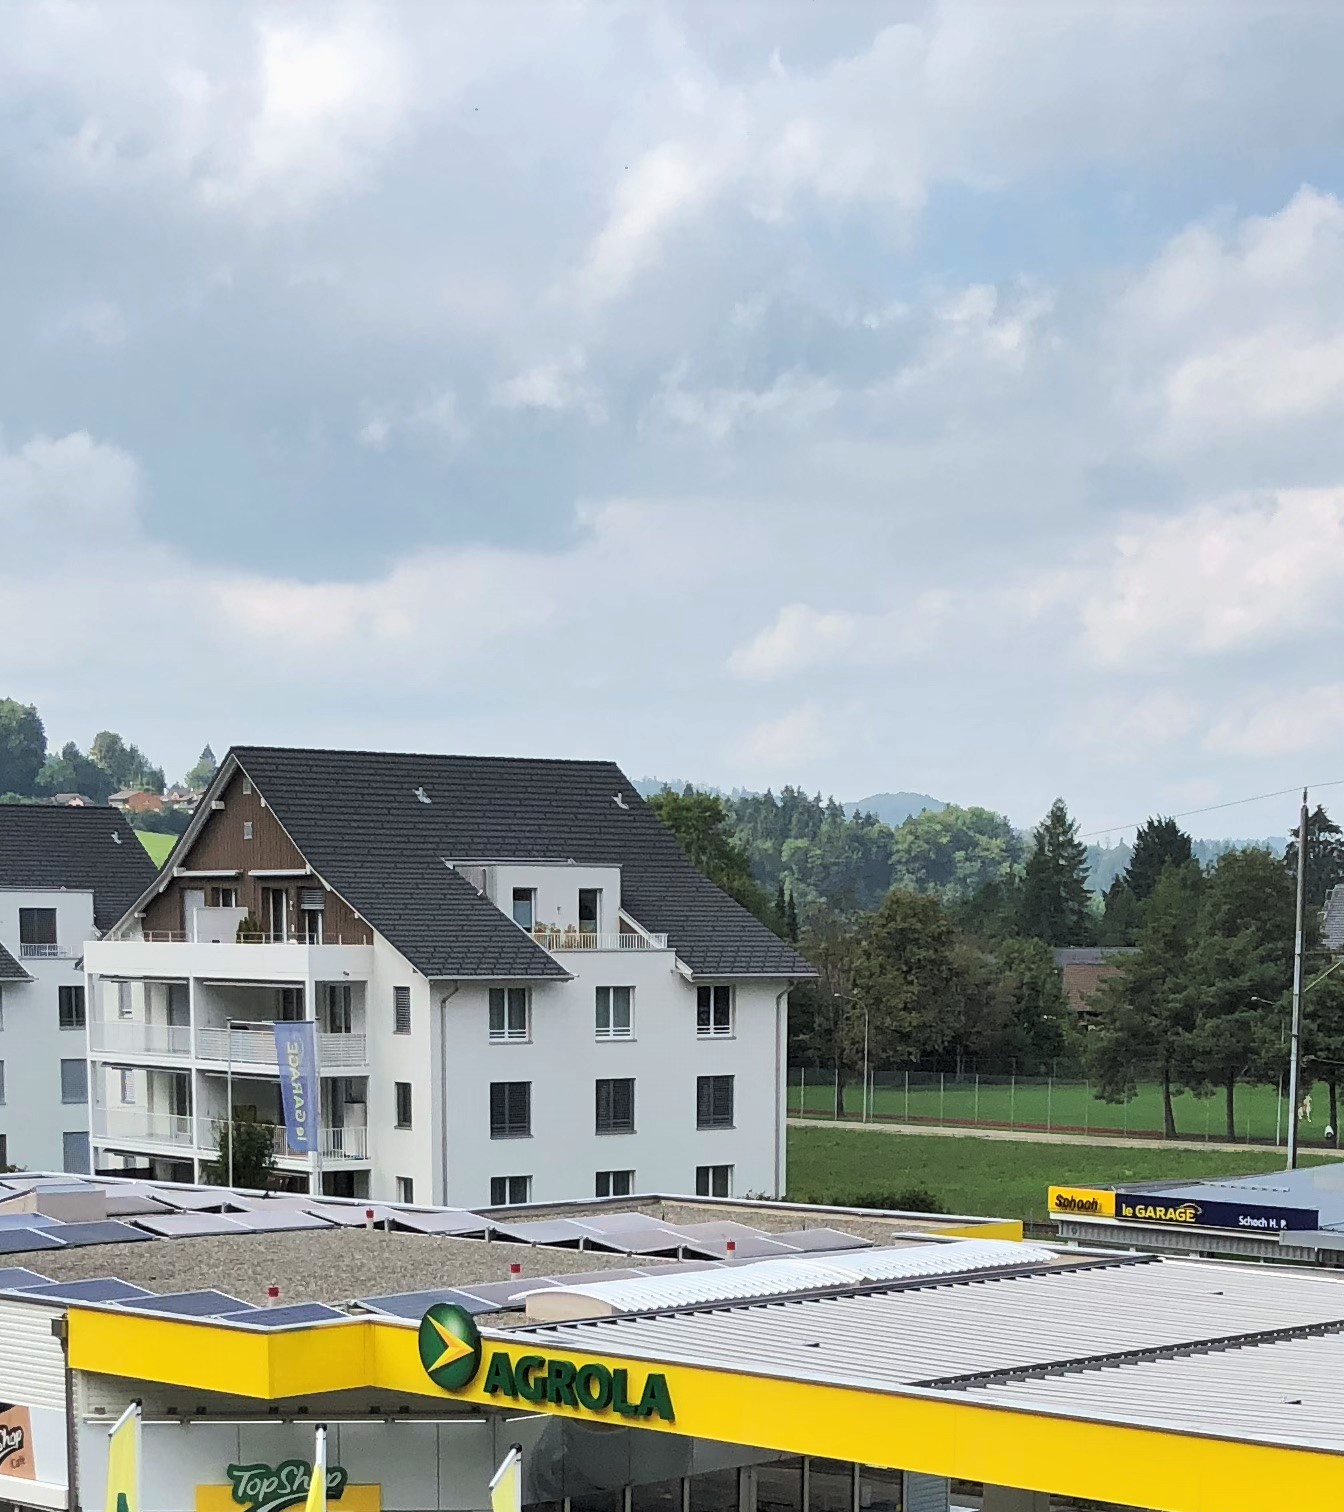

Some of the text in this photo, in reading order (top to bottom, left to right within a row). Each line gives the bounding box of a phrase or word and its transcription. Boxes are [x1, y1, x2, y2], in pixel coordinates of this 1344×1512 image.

[1121, 1203, 1197, 1222] le GARAGE
[1238, 1215, 1267, 1228] Schoch
[483, 1351, 676, 1422] AGROLA
[233, 1465, 342, 1502] TopShp
